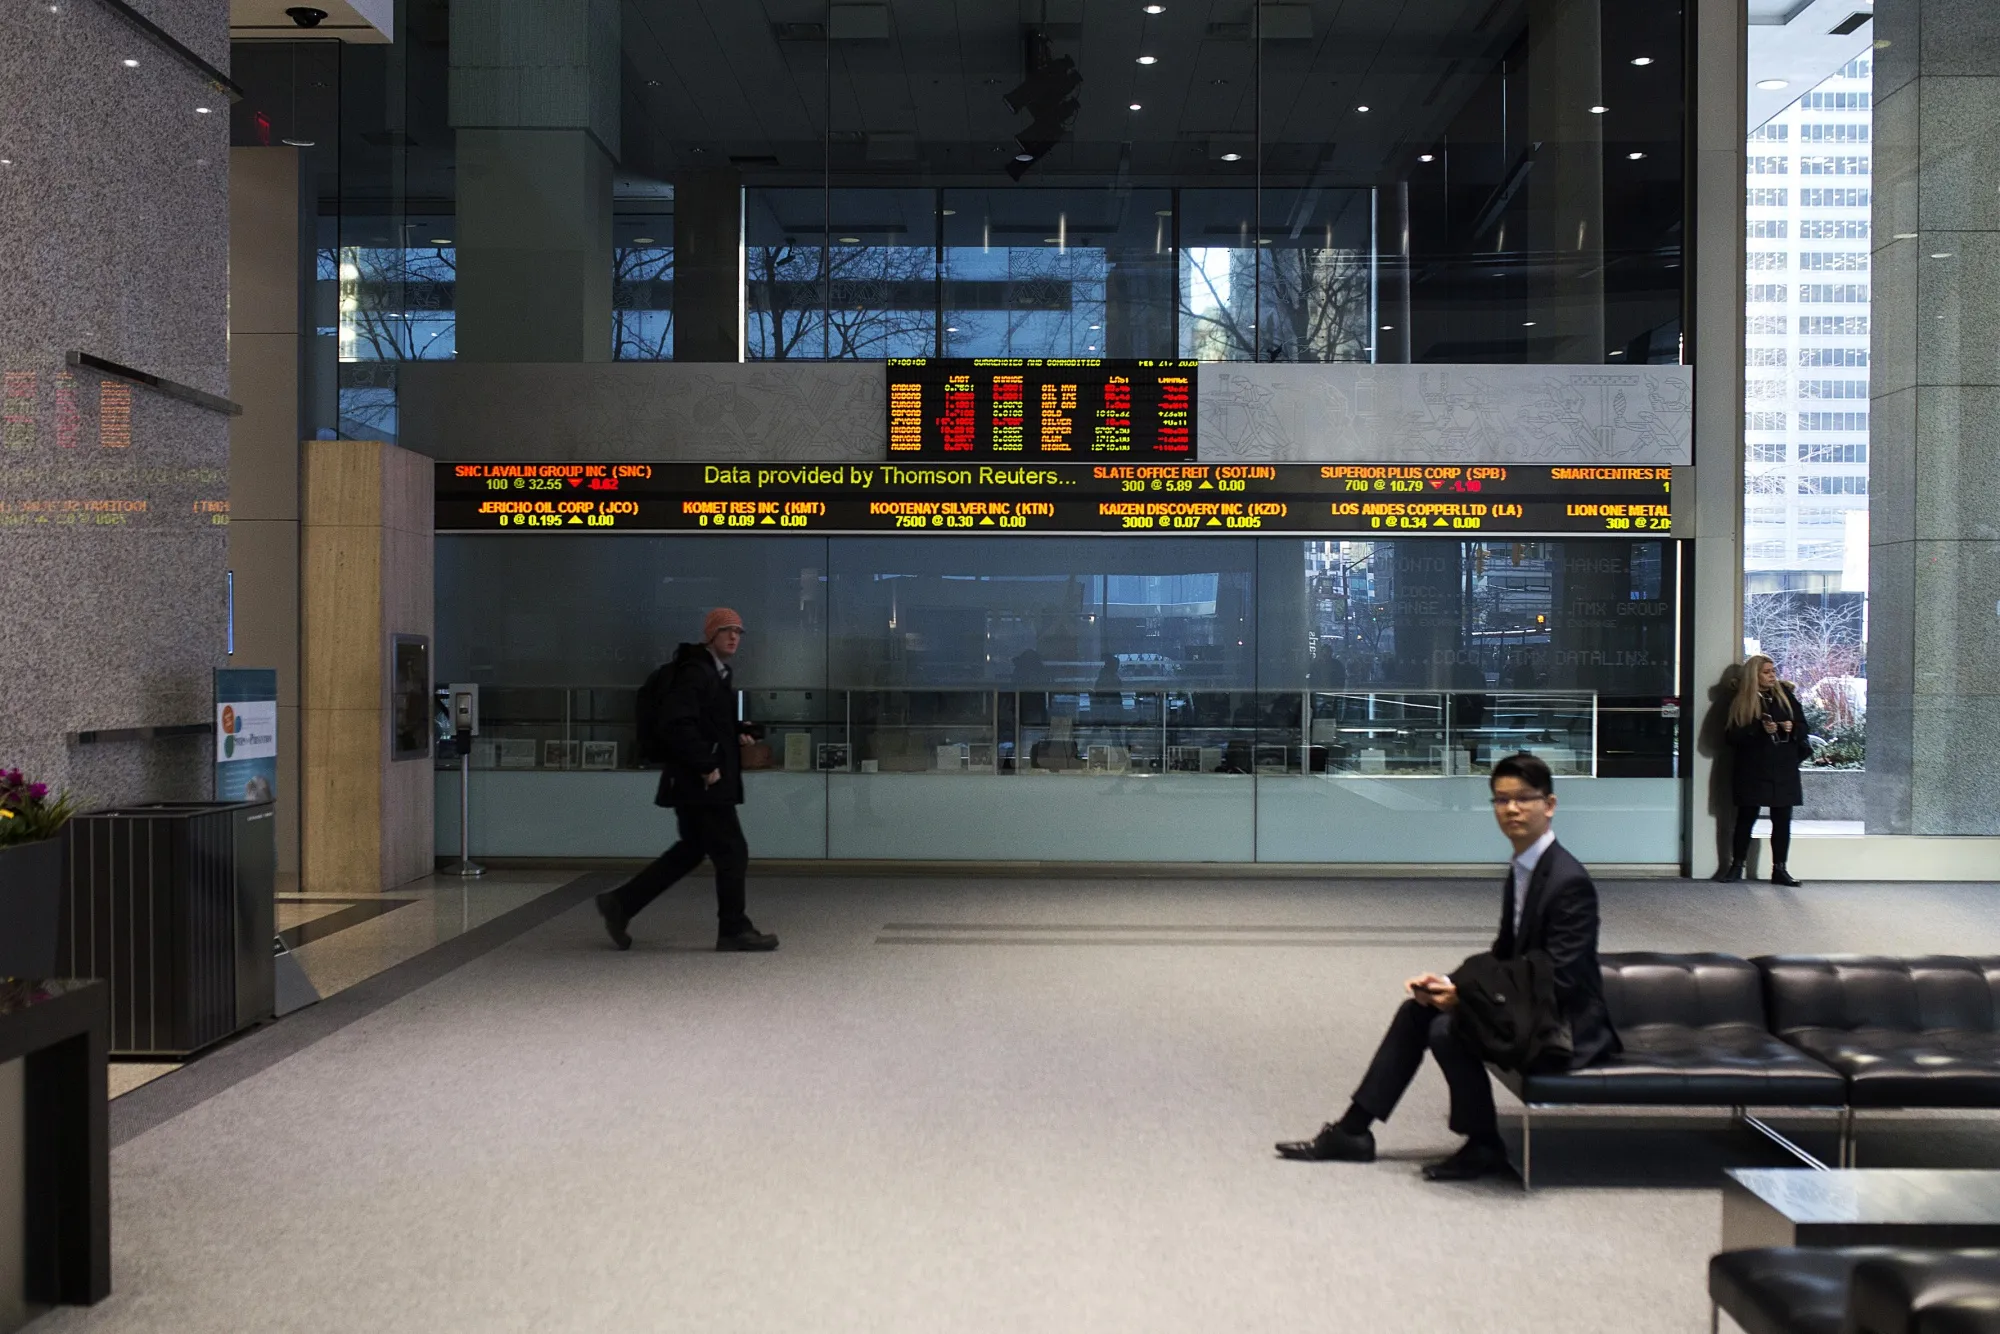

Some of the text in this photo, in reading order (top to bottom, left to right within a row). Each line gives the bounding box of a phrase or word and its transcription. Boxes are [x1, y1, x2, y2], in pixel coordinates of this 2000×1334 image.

[455, 465, 652, 479] SNC LAVALIN GROUP INC (SNC)
[705, 466, 1076, 488] Data provided by Thomson Reuters...
[1093, 467, 1135, 479] SLATE
[1137, 467, 1180, 479] OFFICE
[1182, 467, 1209, 479] REIT
[1320, 467, 1507, 481] SUPERIOR PLUS CORP (SPB)
[1551, 468, 1653, 479] SMARTCENTRES
[486, 479, 508, 490] 100
[513, 479, 525, 489] @
[529, 479, 562, 490] 32.55
[1122, 480, 1246, 491] 300 @ 5.89 0.00
[1345, 480, 1368, 491] 700
[1374, 480, 1386, 490] @
[1390, 480, 1423, 491] 10.79
[478, 502, 639, 515] JERICHO OIL CORP (JCO)
[682, 502, 826, 516] KOMET RES INC (KMT)
[870, 502, 1055, 517] KOOTENAY SILVER INC (KTN)
[1099, 503, 1287, 517] KAIZEN DISCOVERY INC (KZD)
[1332, 503, 1523, 518] LOS ANDES COPPER LTD (LA)
[1567, 505, 1672, 516] LION ONE METAL
[500, 515, 615, 526] 0 @ 0.195 0.00
[699, 514, 807, 527] 0 @ 0.09 0.00
[895, 515, 1026, 527] 7500 @ 0.30 0.00
[1122, 517, 1261, 528] 3000 @ 0.07 0.005
[1371, 516, 1481, 528] 0 @ 0.34 0.00
[1606, 518, 1629, 529] 300
[1635, 517, 1647, 527] @
[1617, 601, 1669, 616] GROUP
